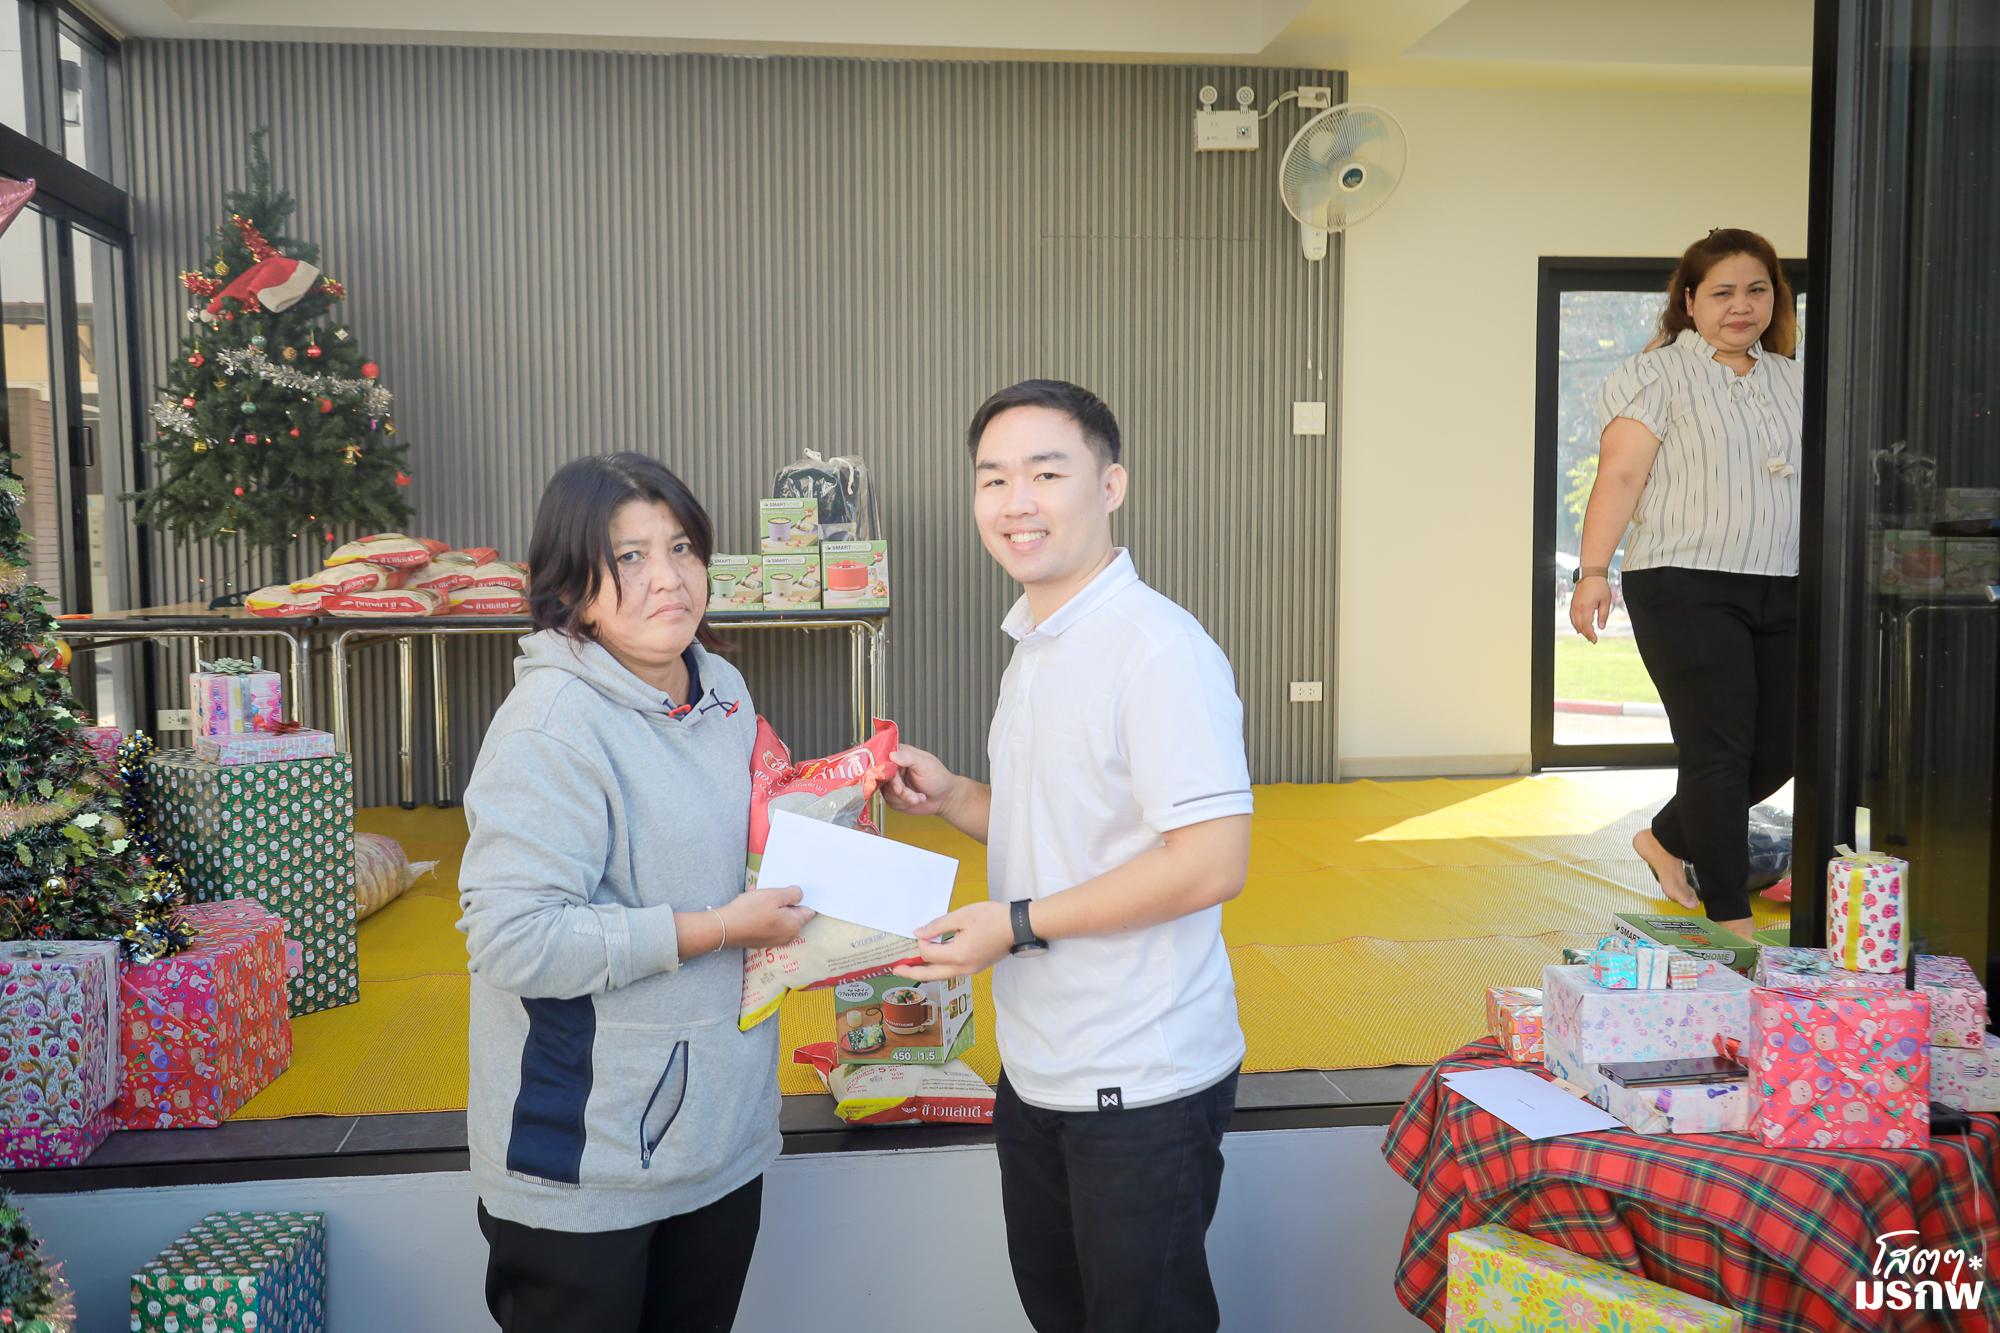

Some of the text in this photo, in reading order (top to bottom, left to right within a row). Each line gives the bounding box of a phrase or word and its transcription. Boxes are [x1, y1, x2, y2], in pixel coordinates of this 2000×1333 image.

[765, 947, 775, 964] 5
[893, 1052, 912, 1061] 450
[920, 1051, 936, 1061] 1.5
